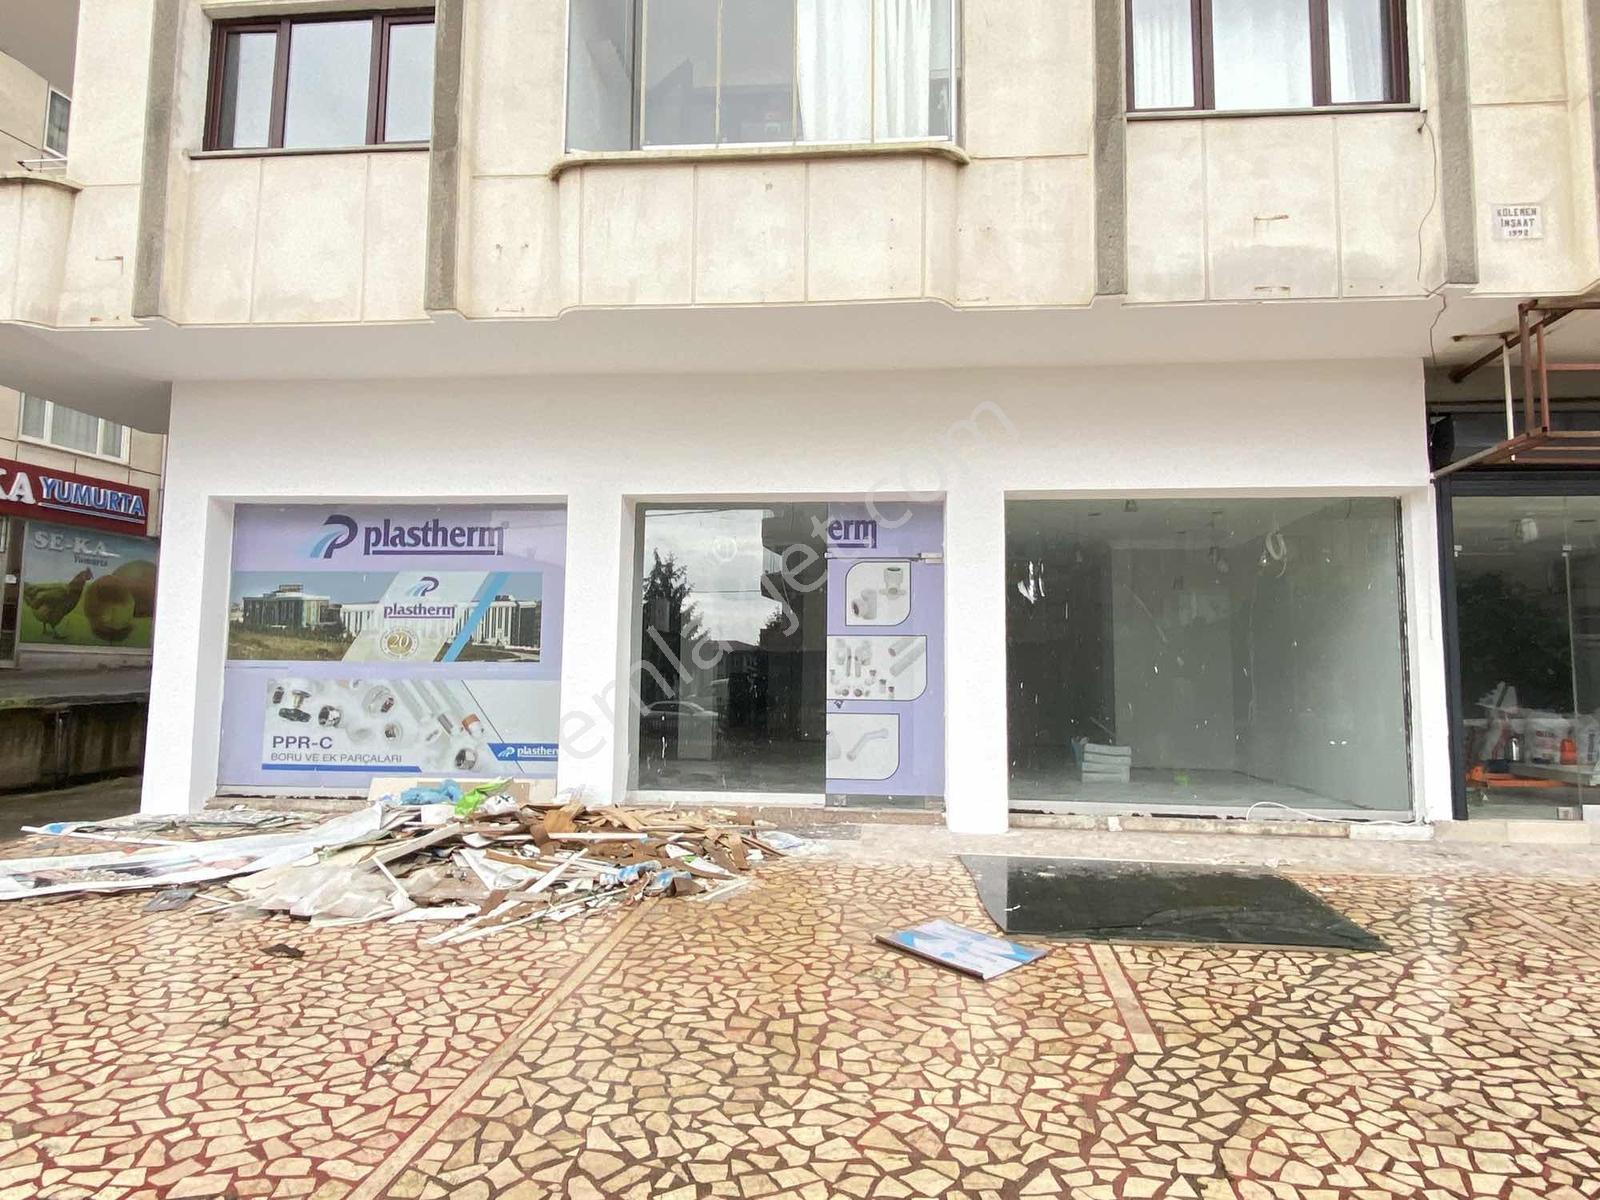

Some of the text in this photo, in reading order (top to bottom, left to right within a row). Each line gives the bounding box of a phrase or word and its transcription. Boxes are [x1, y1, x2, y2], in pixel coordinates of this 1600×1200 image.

[39, 476, 146, 517] YUMURTA
[33, 530, 116, 557] SE-KA
[363, 518, 504, 556] plastherm
[384, 603, 455, 619] plastherm
[390, 634, 410, 648] 20
[272, 735, 333, 749] PPR-C
[270, 752, 402, 765] BORU VE EK PARÇALARI
